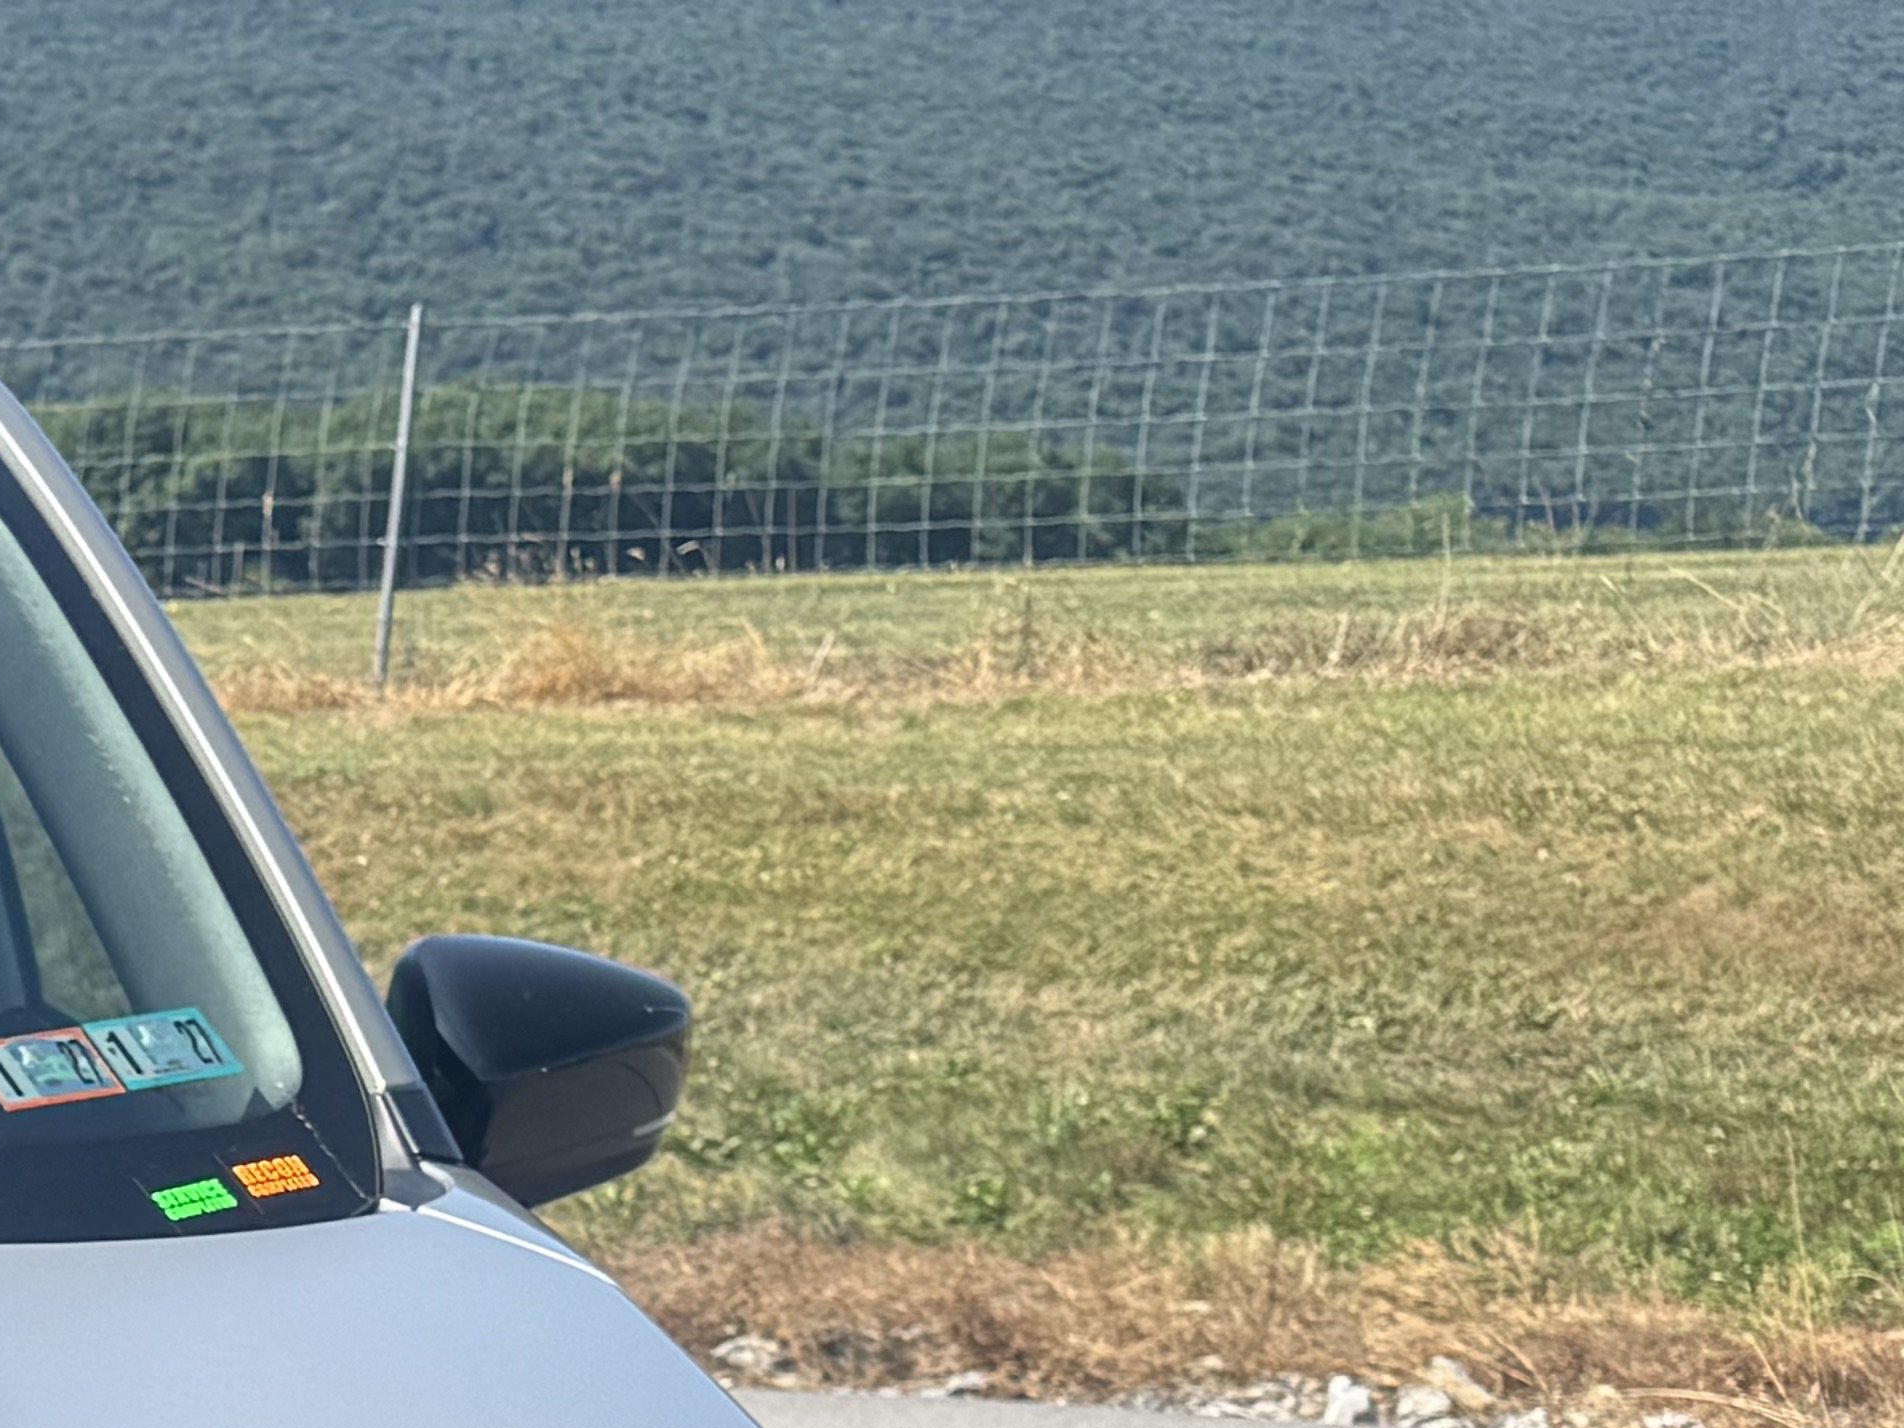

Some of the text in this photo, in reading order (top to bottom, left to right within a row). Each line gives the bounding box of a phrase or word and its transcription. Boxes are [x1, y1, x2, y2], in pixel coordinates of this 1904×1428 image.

[55, 1039, 106, 1088] 27
[173, 1018, 224, 1065] 27
[232, 1154, 309, 1187] RECON
